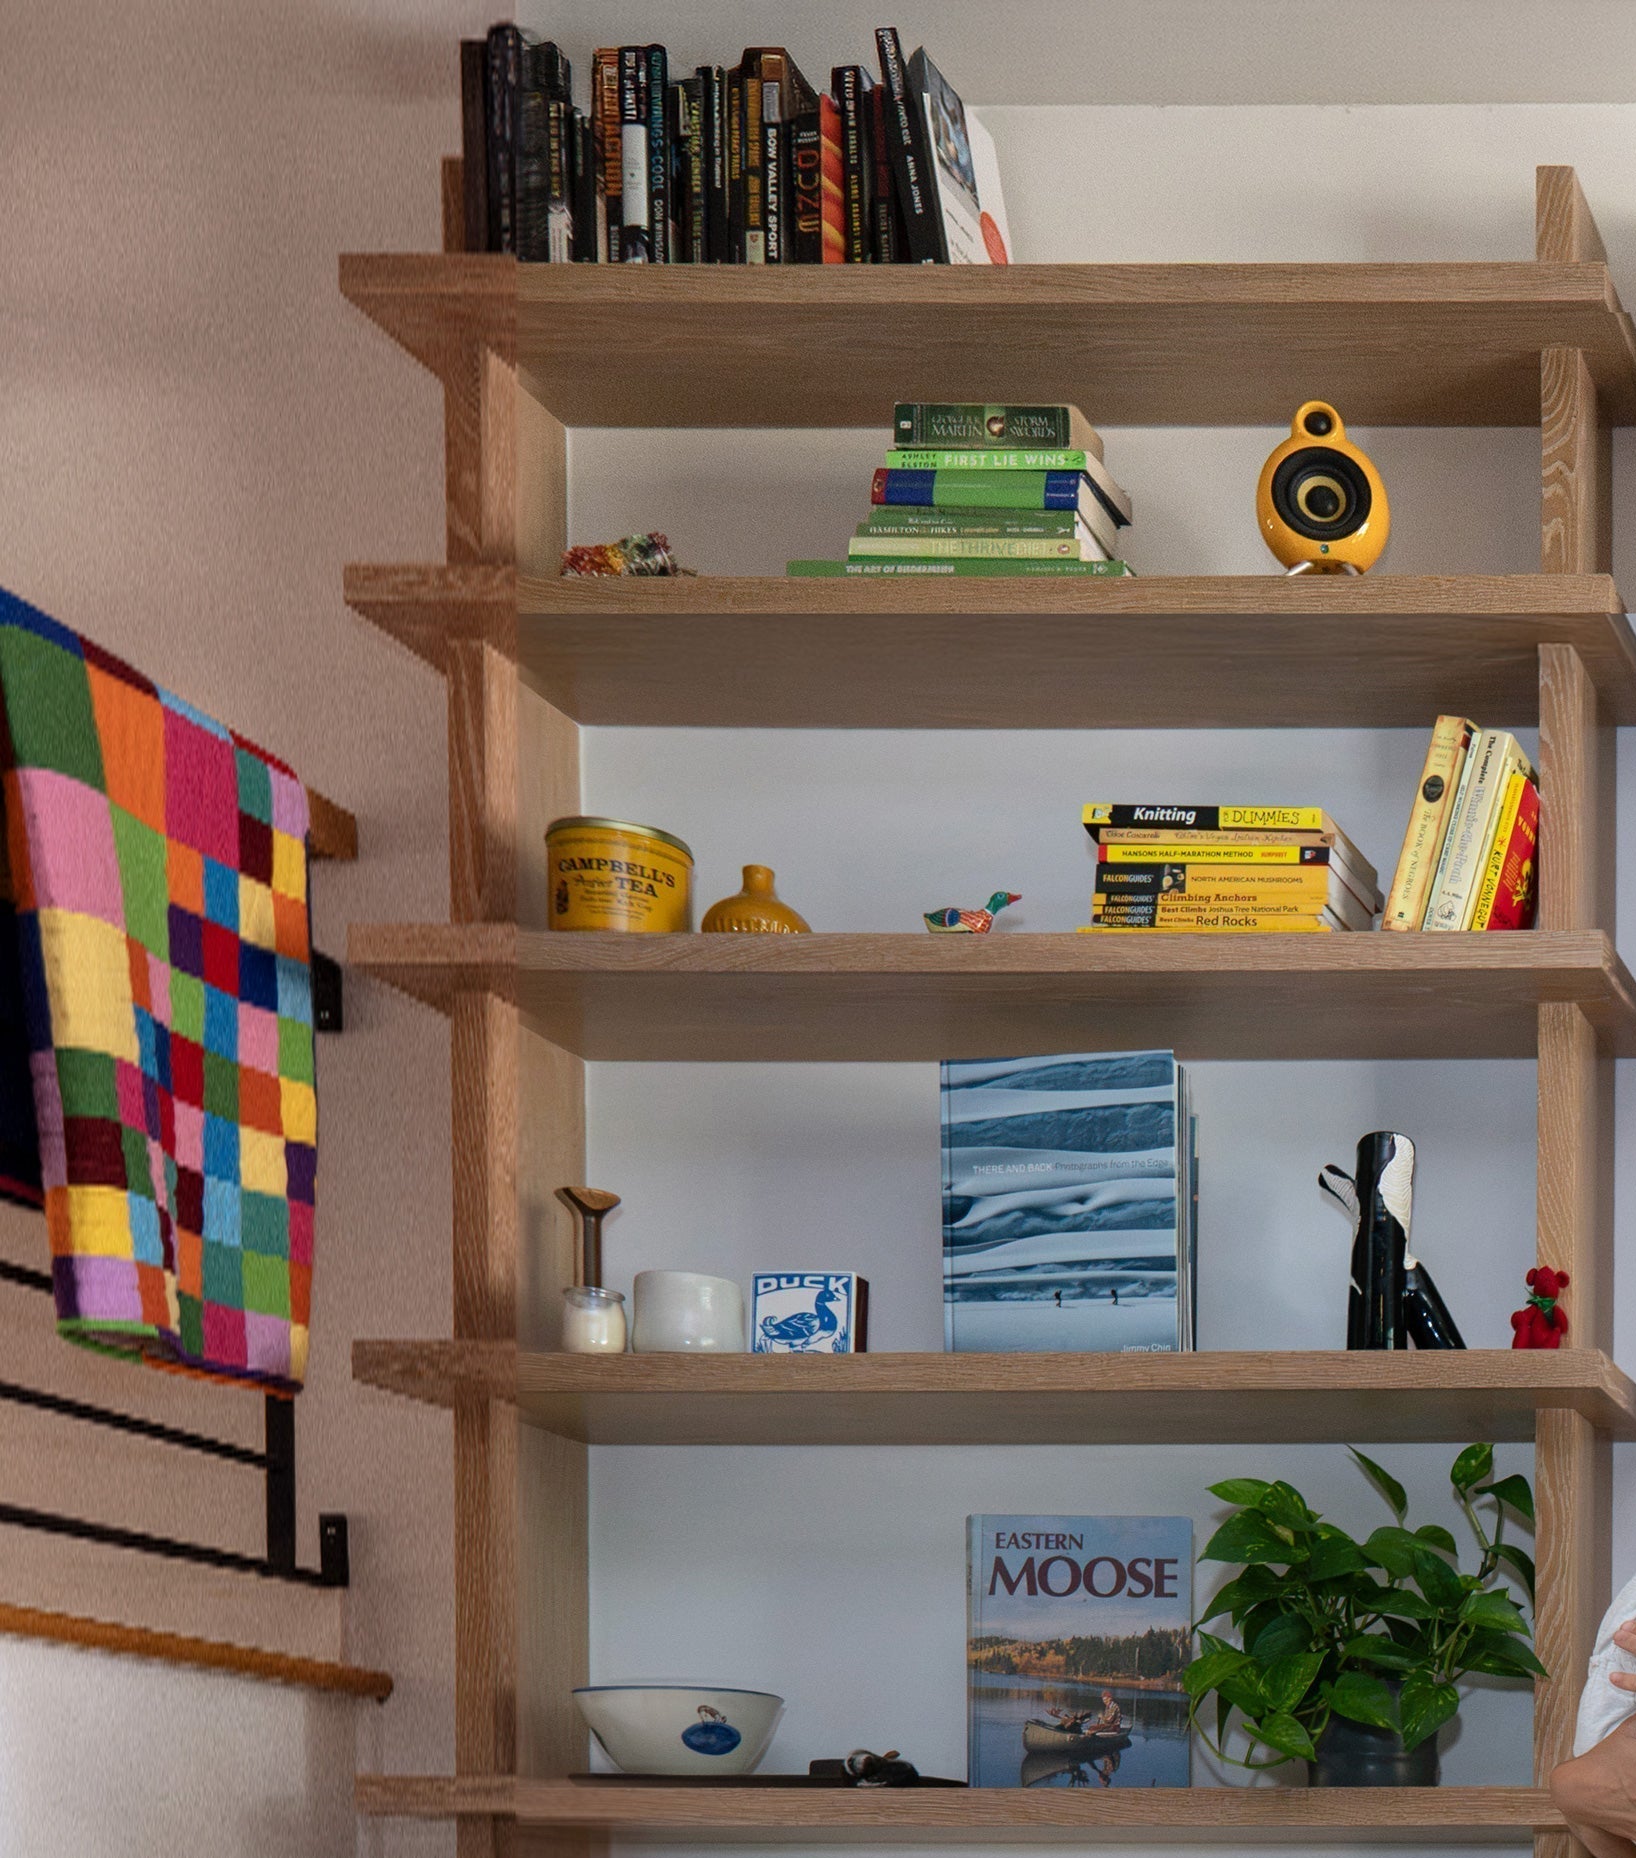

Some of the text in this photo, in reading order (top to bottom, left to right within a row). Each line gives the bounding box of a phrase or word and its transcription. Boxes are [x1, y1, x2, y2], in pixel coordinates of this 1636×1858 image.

[651, 156, 664, 192] COOL
[768, 128, 777, 259] BOW VALLEY SPORT
[905, 156, 923, 214] ANNA JONES
[945, 455, 1066, 466] FIRST LIE WINS
[1478, 736, 1496, 784] The Complete
[1134, 807, 1299, 825] Knitting DUMMIES
[559, 857, 675, 888] CAMPBELL'S
[1103, 874, 1152, 883] FALCONGUIDES
[615, 877, 658, 898] TEA
[1476, 849, 1503, 928] KURT VONNEGUT
[1161, 894, 1210, 903] Climbing
[1196, 916, 1257, 925] Red Rocks
[973, 1166, 1004, 1174] THERE
[1006, 1165, 1025, 1173] AND
[1029, 1164, 1052, 1173] BACK
[1110, 1160, 1129, 1169] from
[1131, 1159, 1145, 1168] the
[757, 1276, 849, 1295] DUCK
[995, 1533, 1083, 1550] EASTERN
[988, 1556, 1178, 1598] MOOSE
